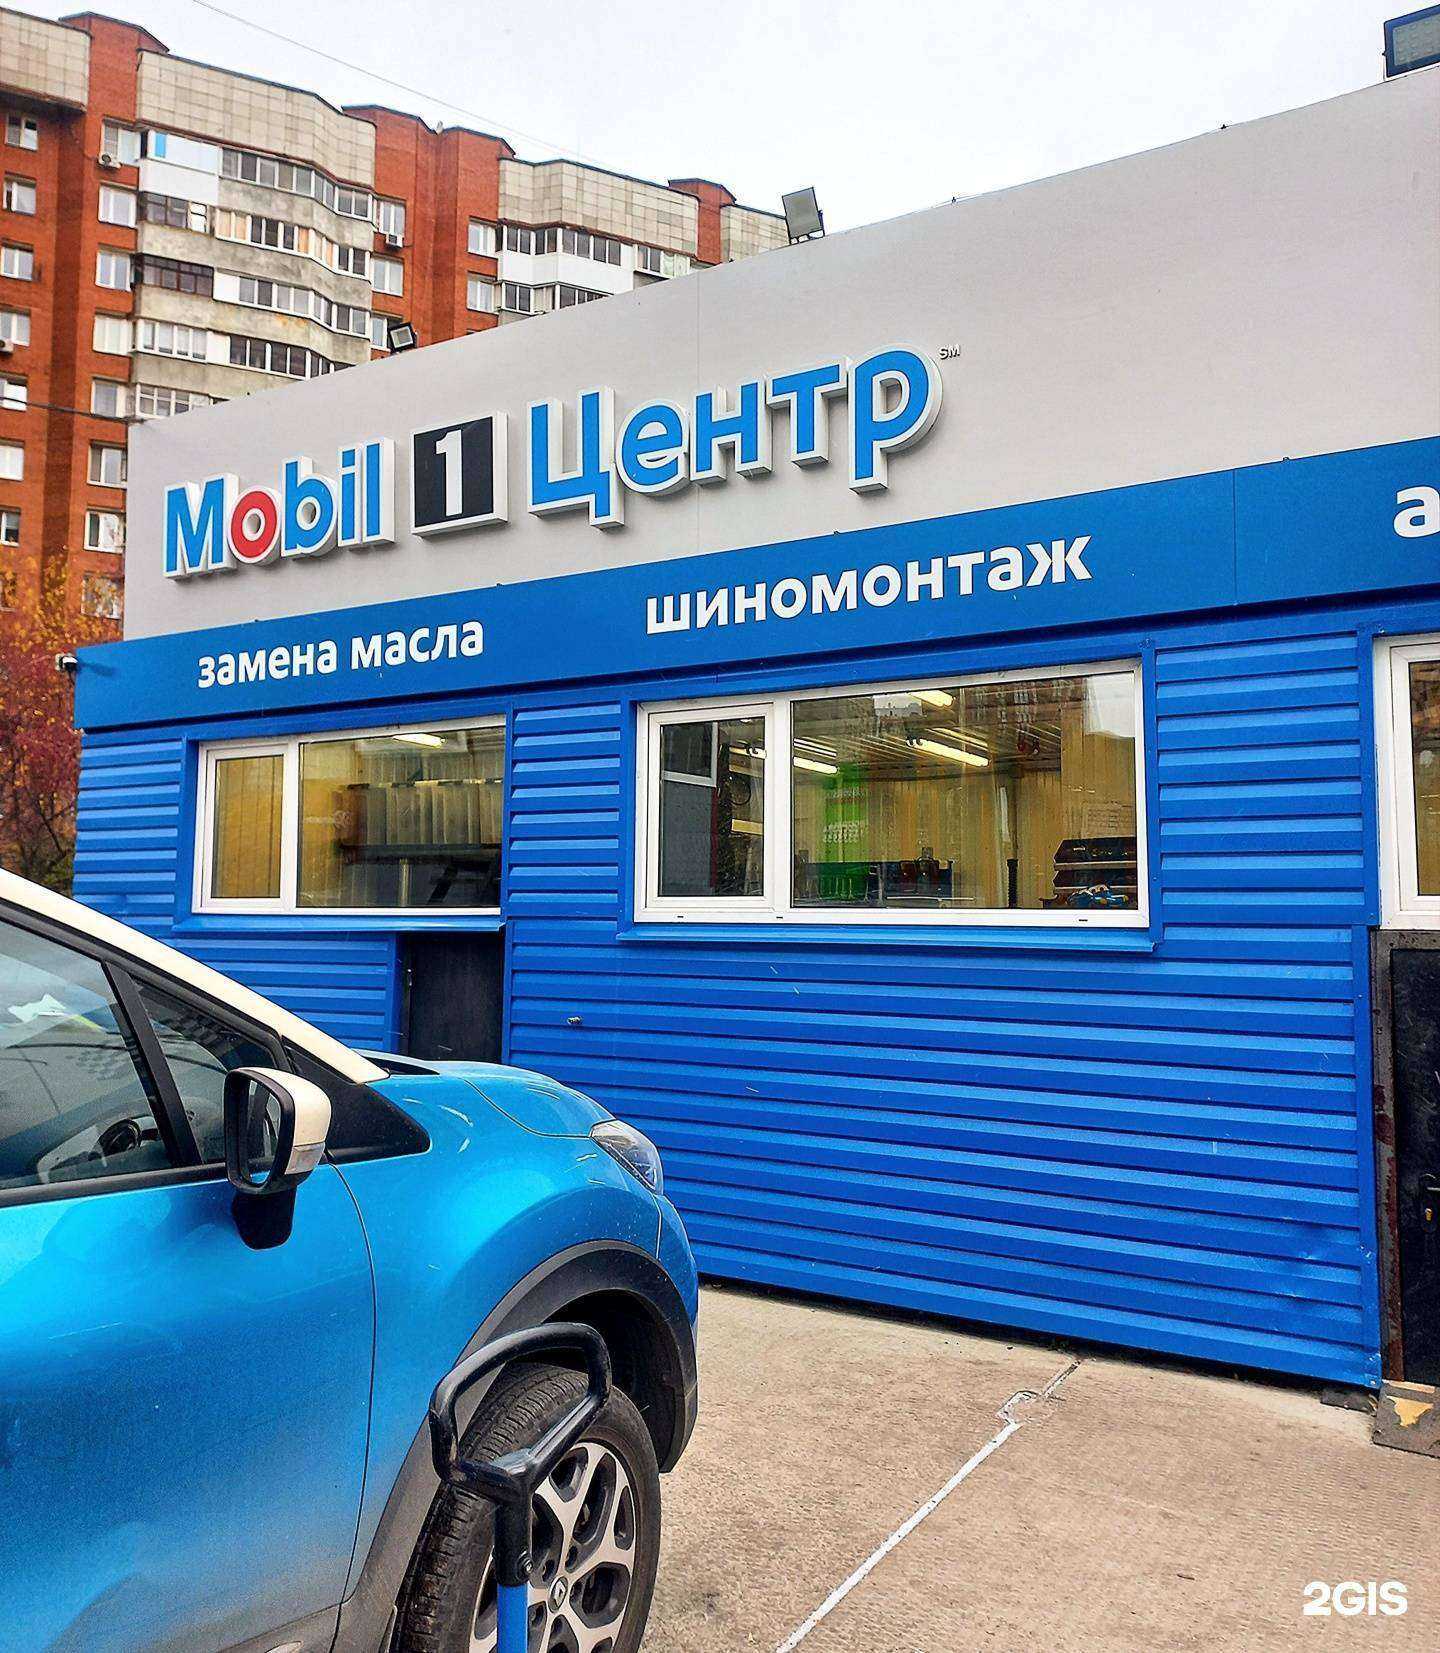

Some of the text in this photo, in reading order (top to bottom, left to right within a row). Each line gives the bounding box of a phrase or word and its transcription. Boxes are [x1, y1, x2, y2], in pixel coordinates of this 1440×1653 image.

[938, 344, 961, 361] SM
[163, 437, 395, 578] Mobil
[527, 343, 943, 527] Центр
[1393, 485, 1440, 538] а
[645, 535, 1092, 635] шиномонтаж
[198, 619, 484, 689] замена масла
